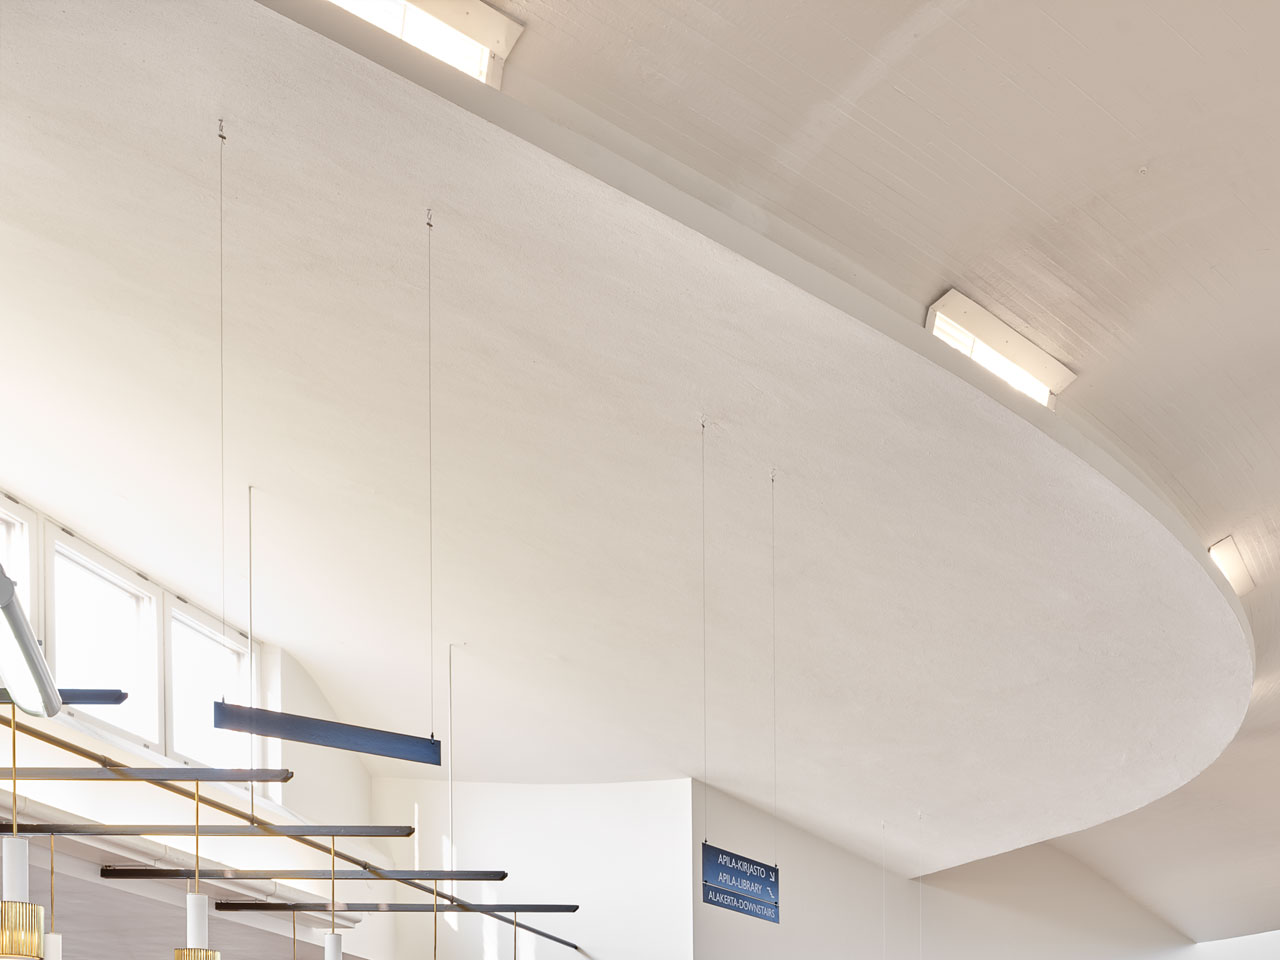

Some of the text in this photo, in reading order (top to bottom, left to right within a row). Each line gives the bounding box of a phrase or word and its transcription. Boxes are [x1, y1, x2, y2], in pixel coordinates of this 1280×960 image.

[717, 853, 766, 878] APILA-KIRJASTO
[718, 872, 762, 894] APILA-LIBRARY
[708, 890, 775, 918] ALAKERTA-DOWNSTAIRS
